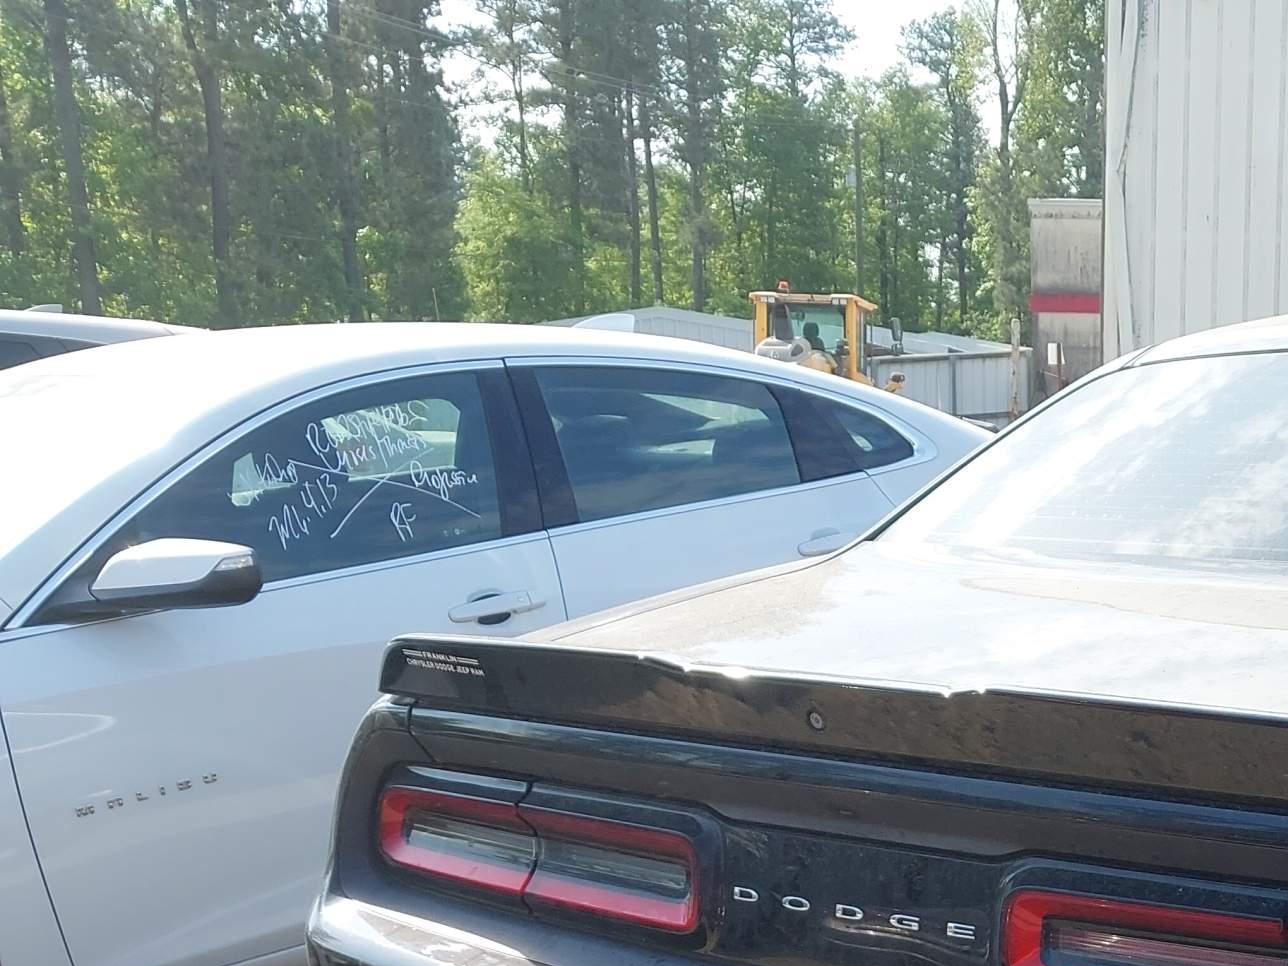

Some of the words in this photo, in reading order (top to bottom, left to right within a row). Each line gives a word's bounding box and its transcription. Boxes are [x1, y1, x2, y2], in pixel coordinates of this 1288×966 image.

[407, 658, 434, 668] CHRYSLER
[456, 666, 470, 674] JEEP
[471, 668, 485, 676] RAM
[422, 651, 457, 662] FRANKLIN
[75, 773, 218, 818] MALIBU
[733, 886, 976, 940] DODGE
